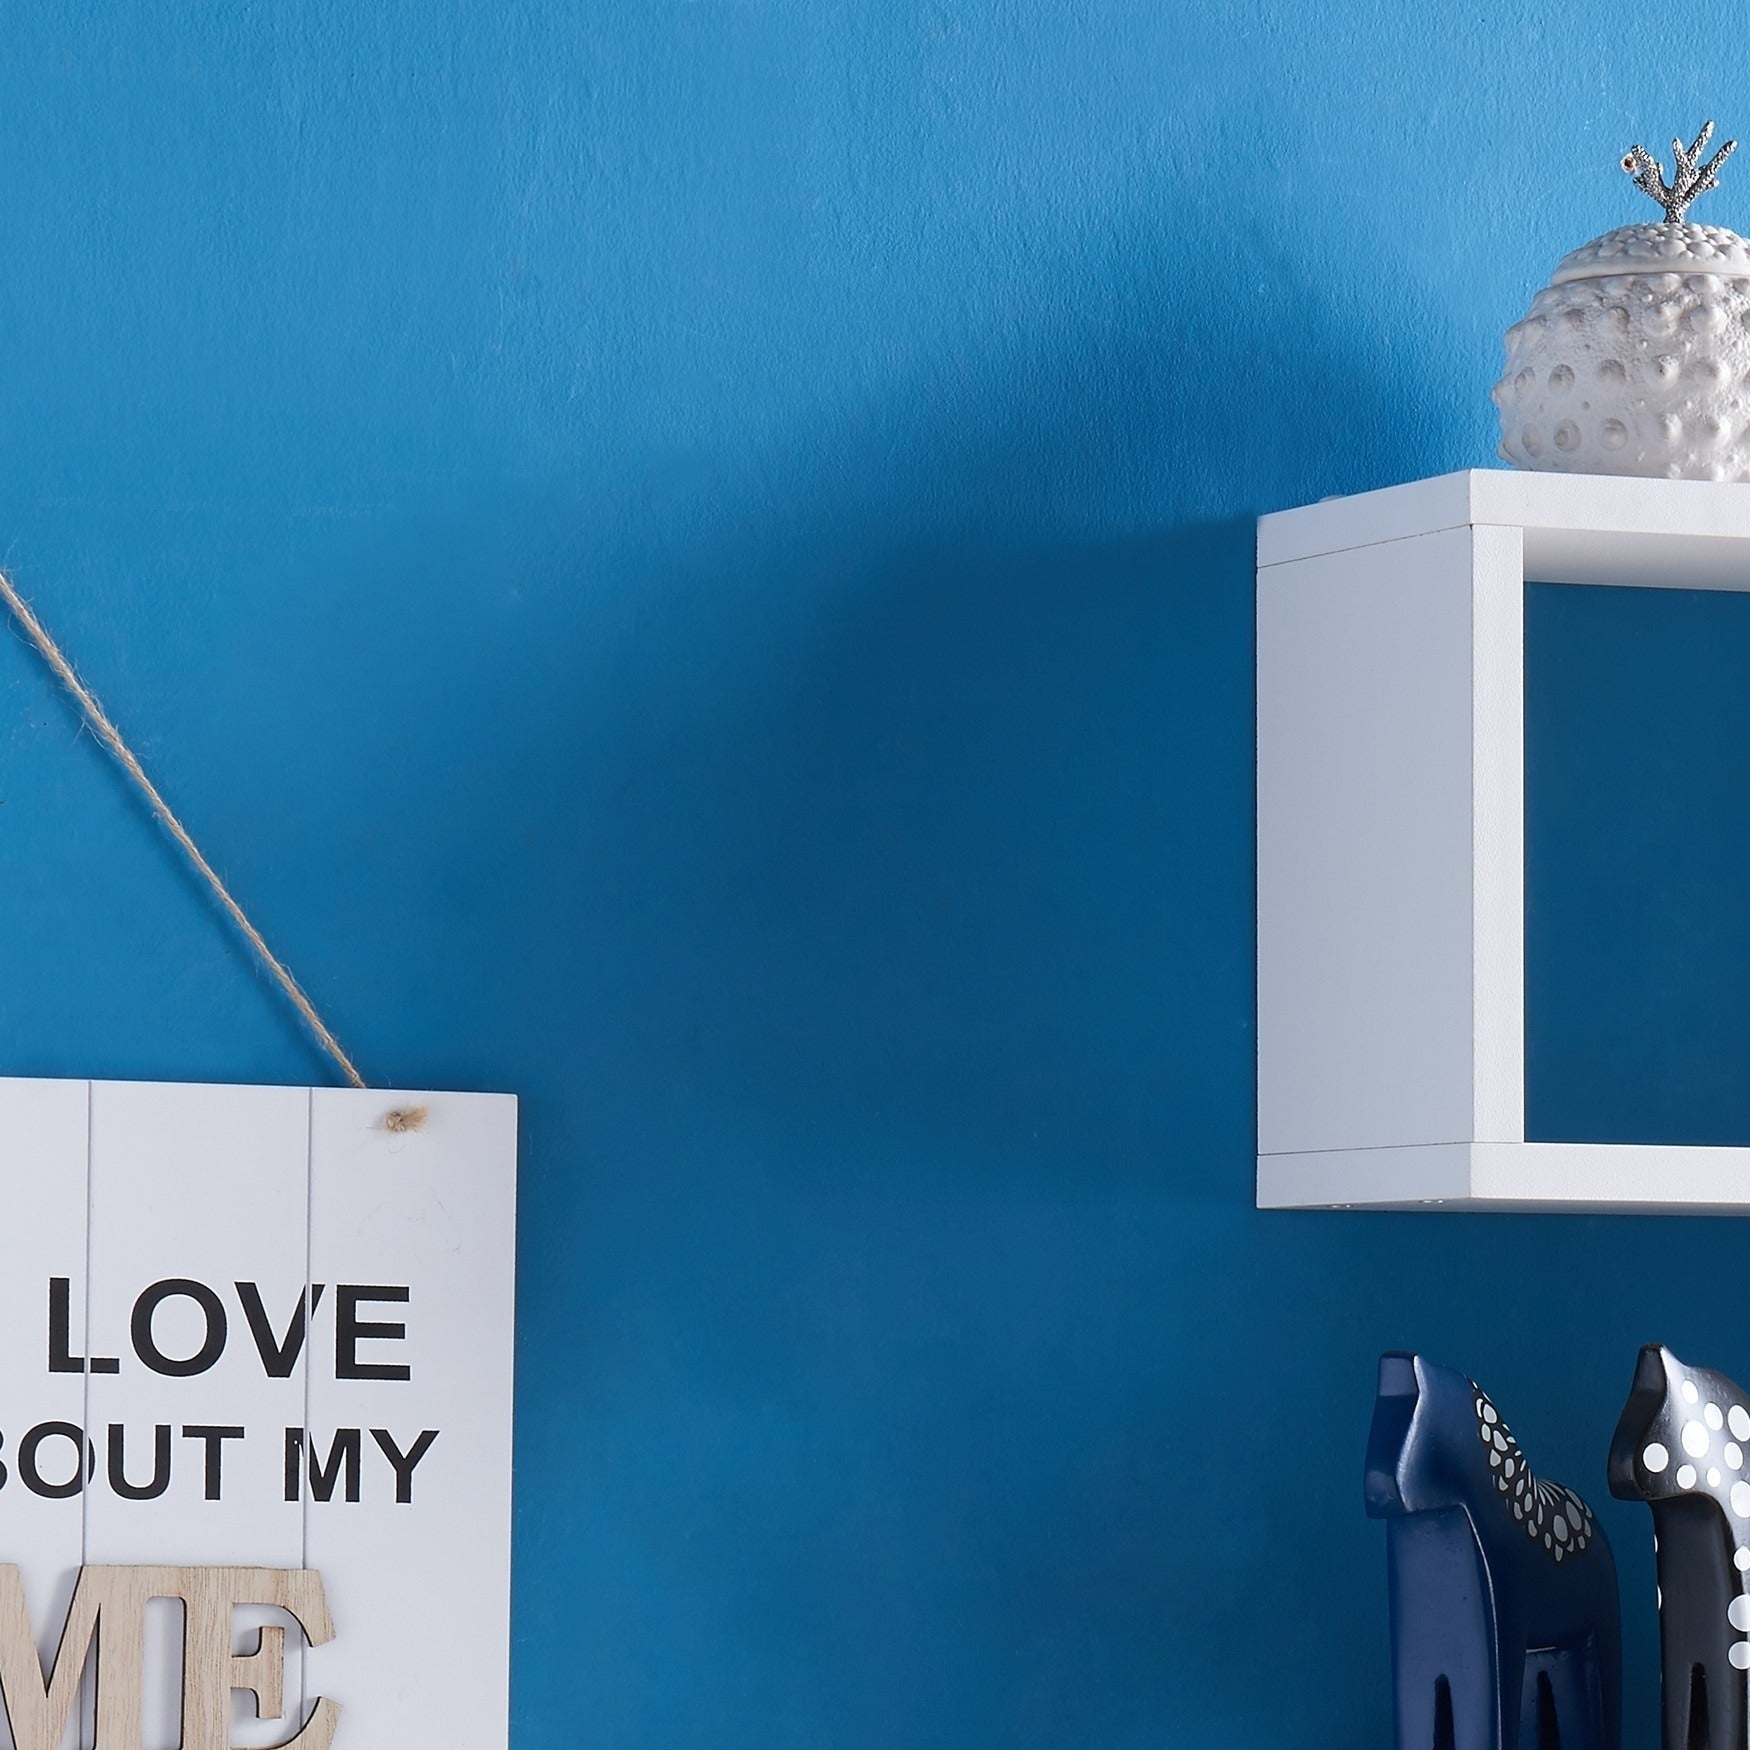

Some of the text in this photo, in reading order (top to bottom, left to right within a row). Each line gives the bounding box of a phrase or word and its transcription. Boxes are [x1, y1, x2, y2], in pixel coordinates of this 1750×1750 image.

[49, 1277, 411, 1380] LOVE
[0, 1421, 440, 1503] OUT MY
